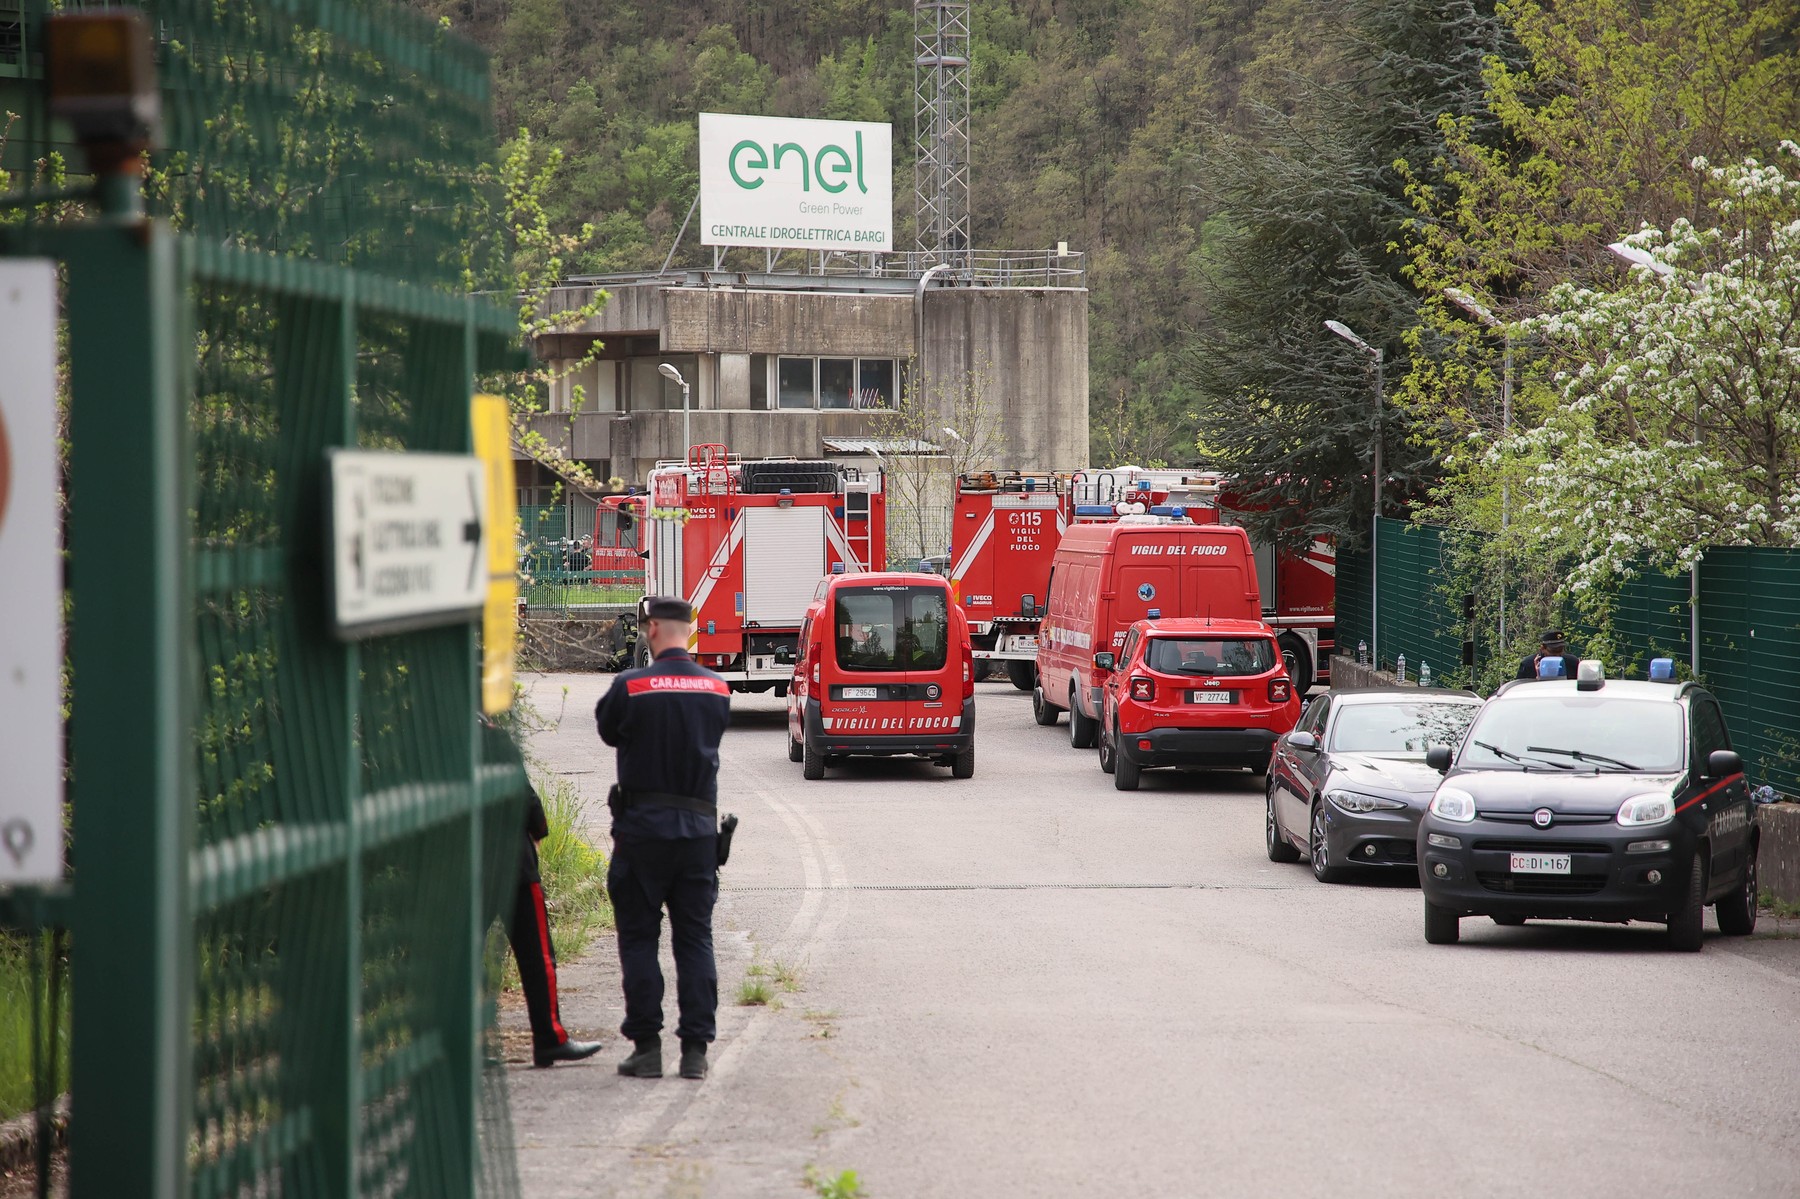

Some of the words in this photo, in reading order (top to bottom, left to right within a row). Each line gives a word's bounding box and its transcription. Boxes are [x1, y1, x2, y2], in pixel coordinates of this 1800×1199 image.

[728, 130, 868, 195] enel
[799, 201, 830, 214] Green
[833, 202, 863, 216] Power
[711, 224, 767, 239] CENTRALE
[770, 226, 851, 241] IDROELETTRICA
[854, 230, 885, 243] BARGI
[1020, 511, 1041, 526] 115
[1010, 527, 1040, 535] VIGILI
[1016, 535, 1034, 543] DEL
[1131, 545, 1164, 555] VIGILI
[1166, 545, 1187, 555] DEL
[1191, 545, 1227, 555] FUOCO
[649, 677, 715, 690] CARABINIERI
[1203, 679, 1221, 687] Jeep
[1195, 692, 1204, 701] VF
[1208, 692, 1228, 702] 27744
[836, 718, 877, 729] VIGILI
[881, 717, 903, 729] DEL
[908, 716, 949, 729] FUOCO
